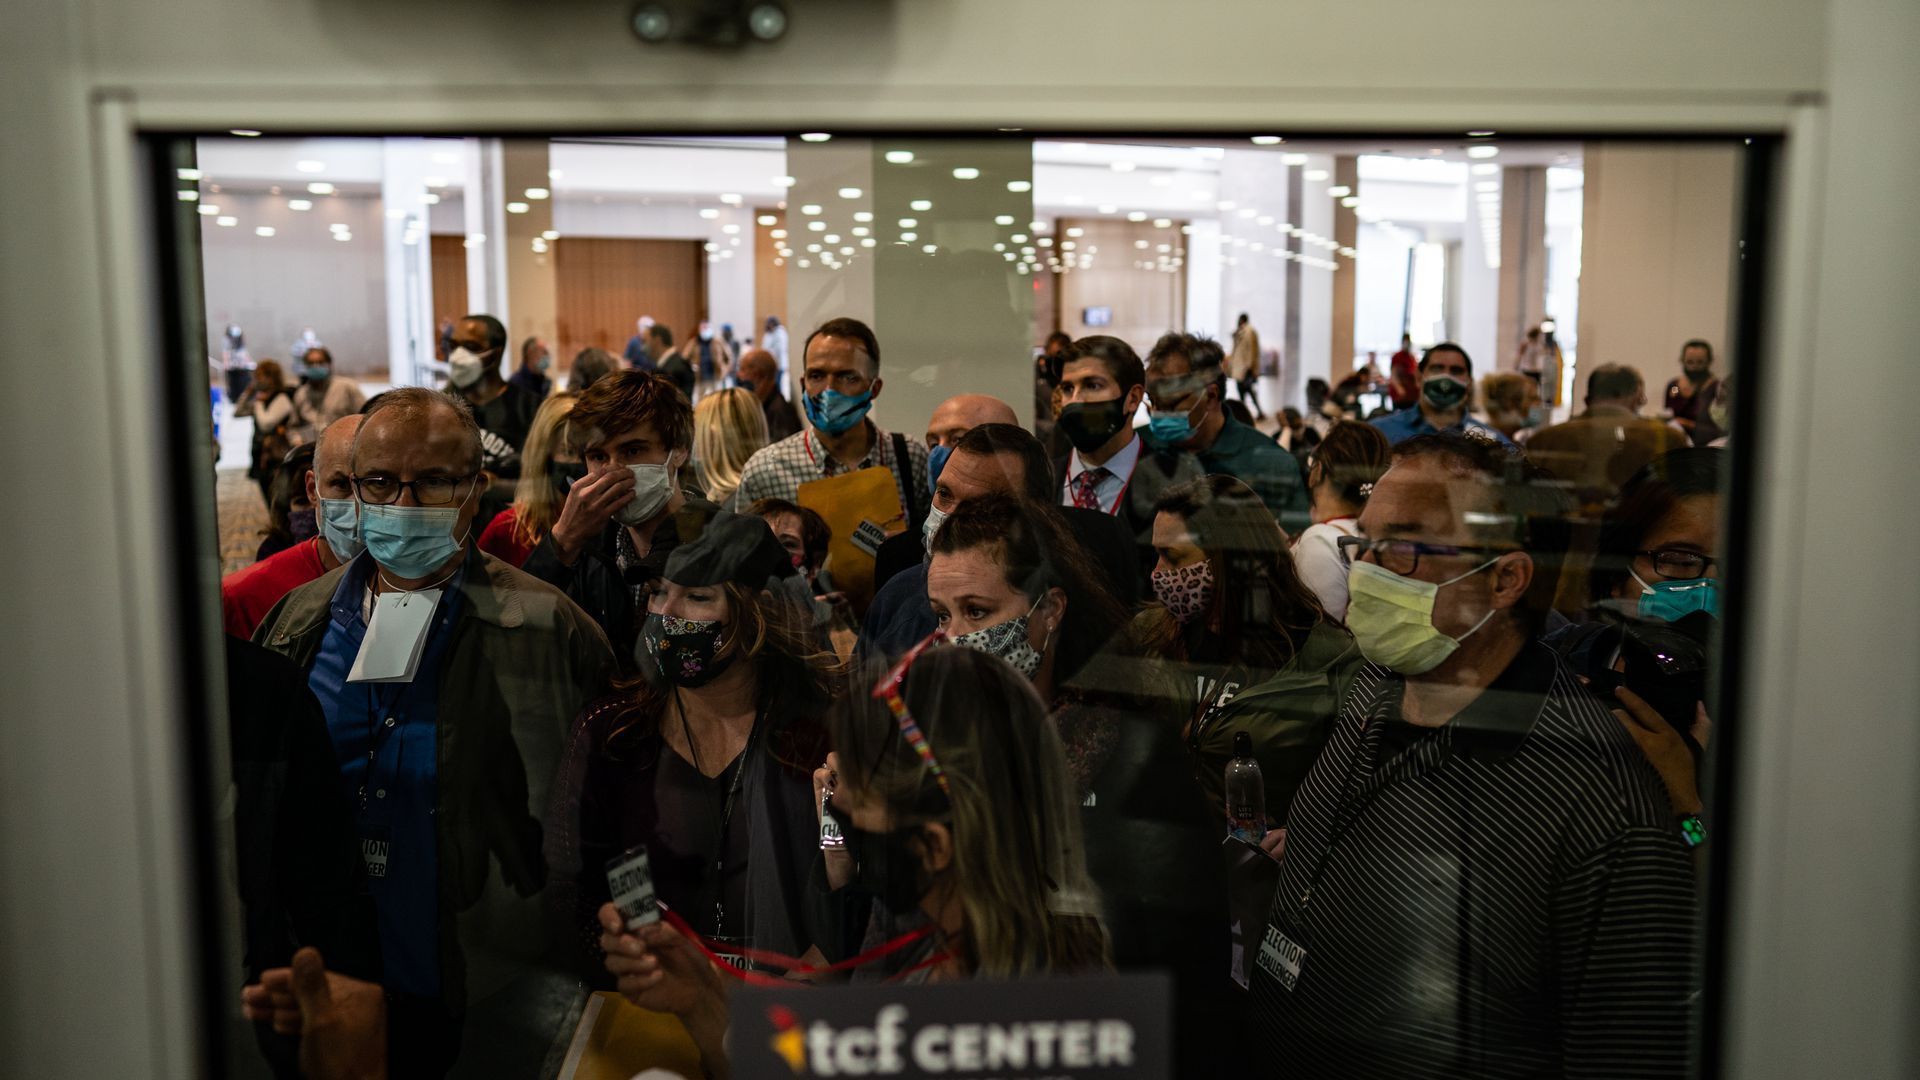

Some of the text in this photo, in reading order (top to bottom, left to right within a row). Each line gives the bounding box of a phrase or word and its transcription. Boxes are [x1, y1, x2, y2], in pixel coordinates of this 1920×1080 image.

[1257, 949, 1297, 989] CHALLENGER
[1263, 924, 1306, 969] ELECTION
[807, 1003, 1134, 1076] tcf CENTER
